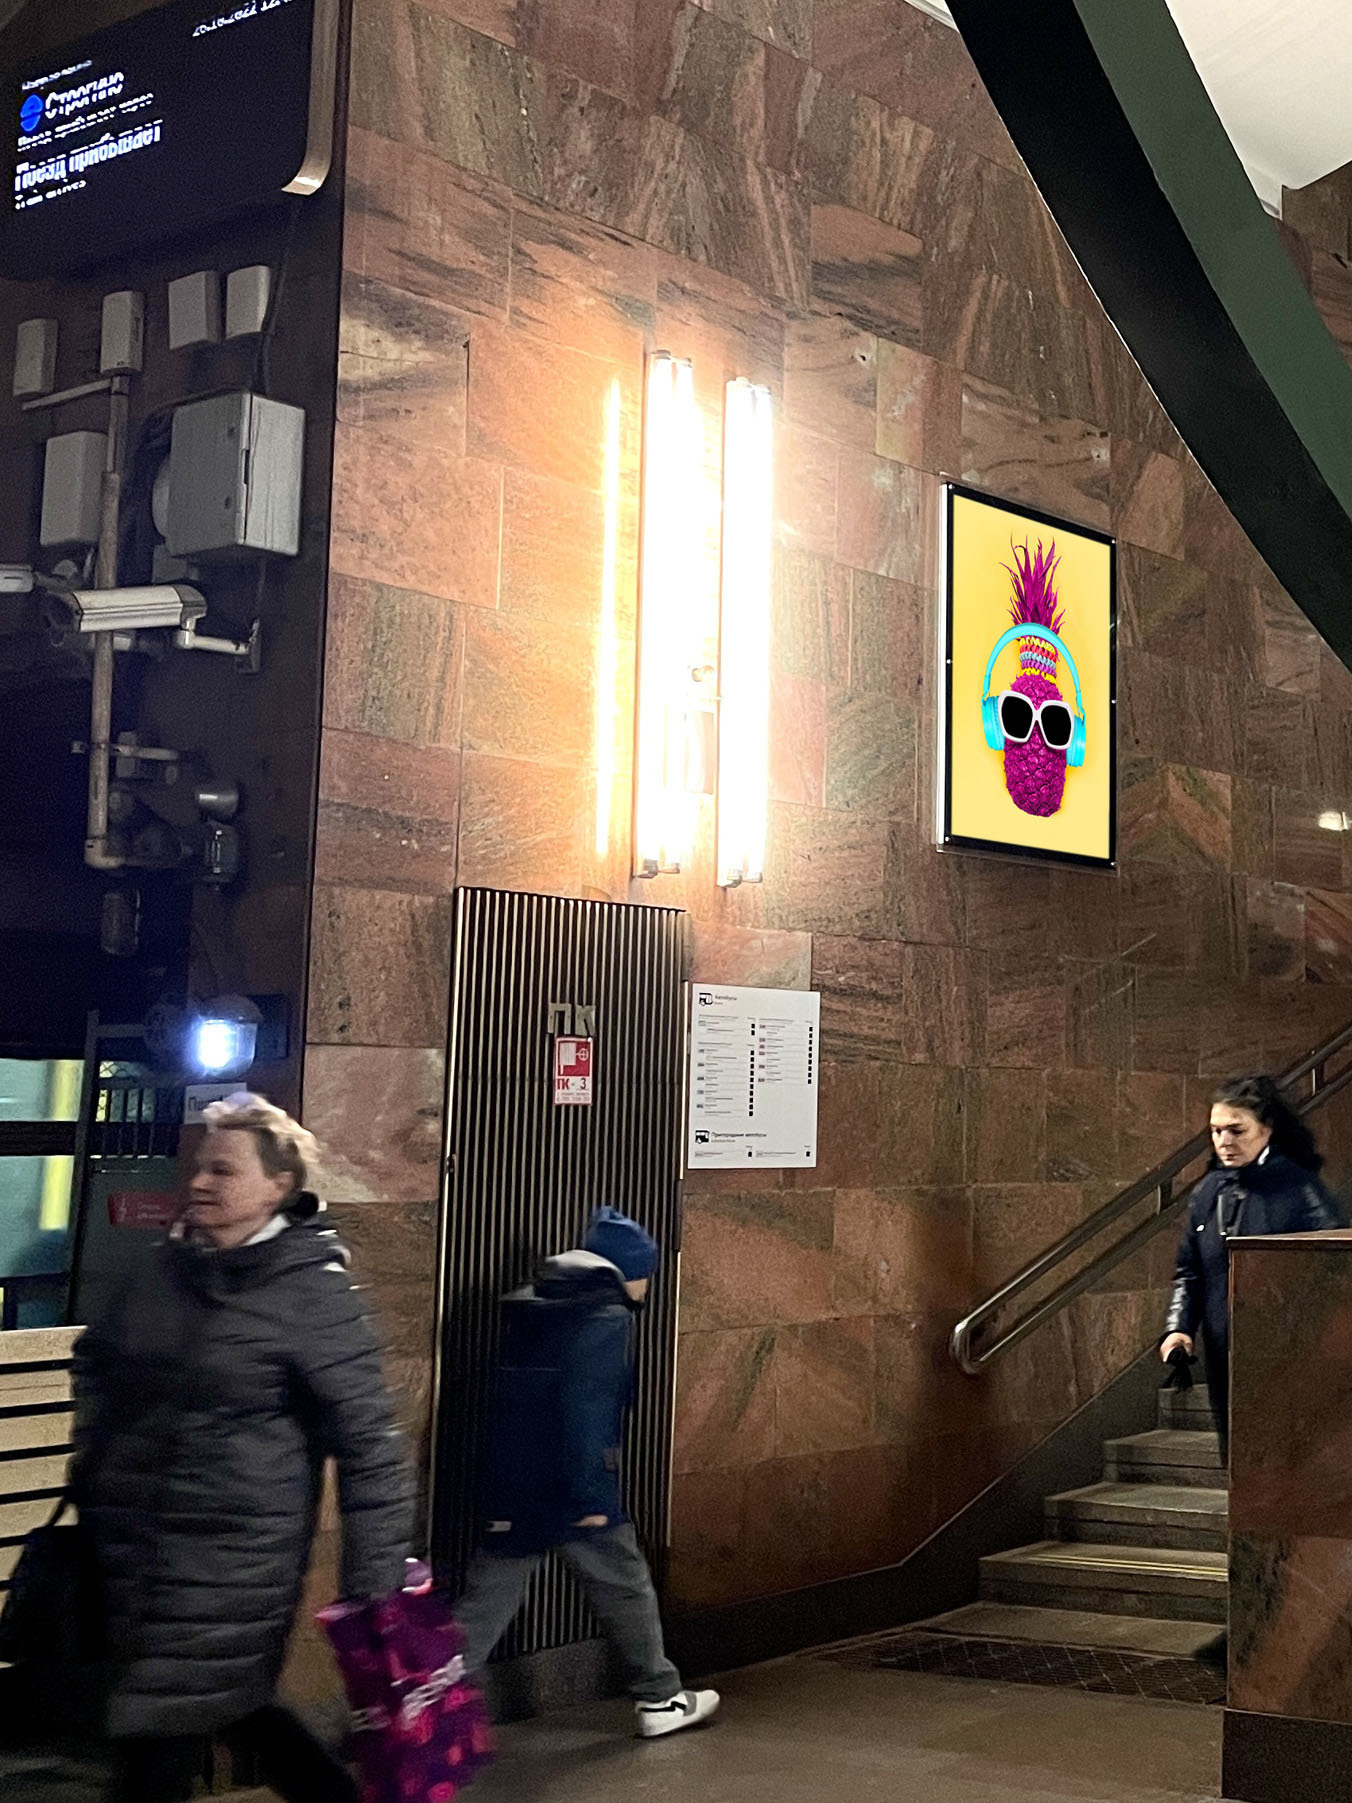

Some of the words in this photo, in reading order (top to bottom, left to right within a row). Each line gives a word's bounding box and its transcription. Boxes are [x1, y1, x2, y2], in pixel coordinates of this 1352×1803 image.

[547, 1002, 597, 1037] ПК
[556, 1078, 570, 1090] ПК
[580, 1077, 587, 1090] 3
